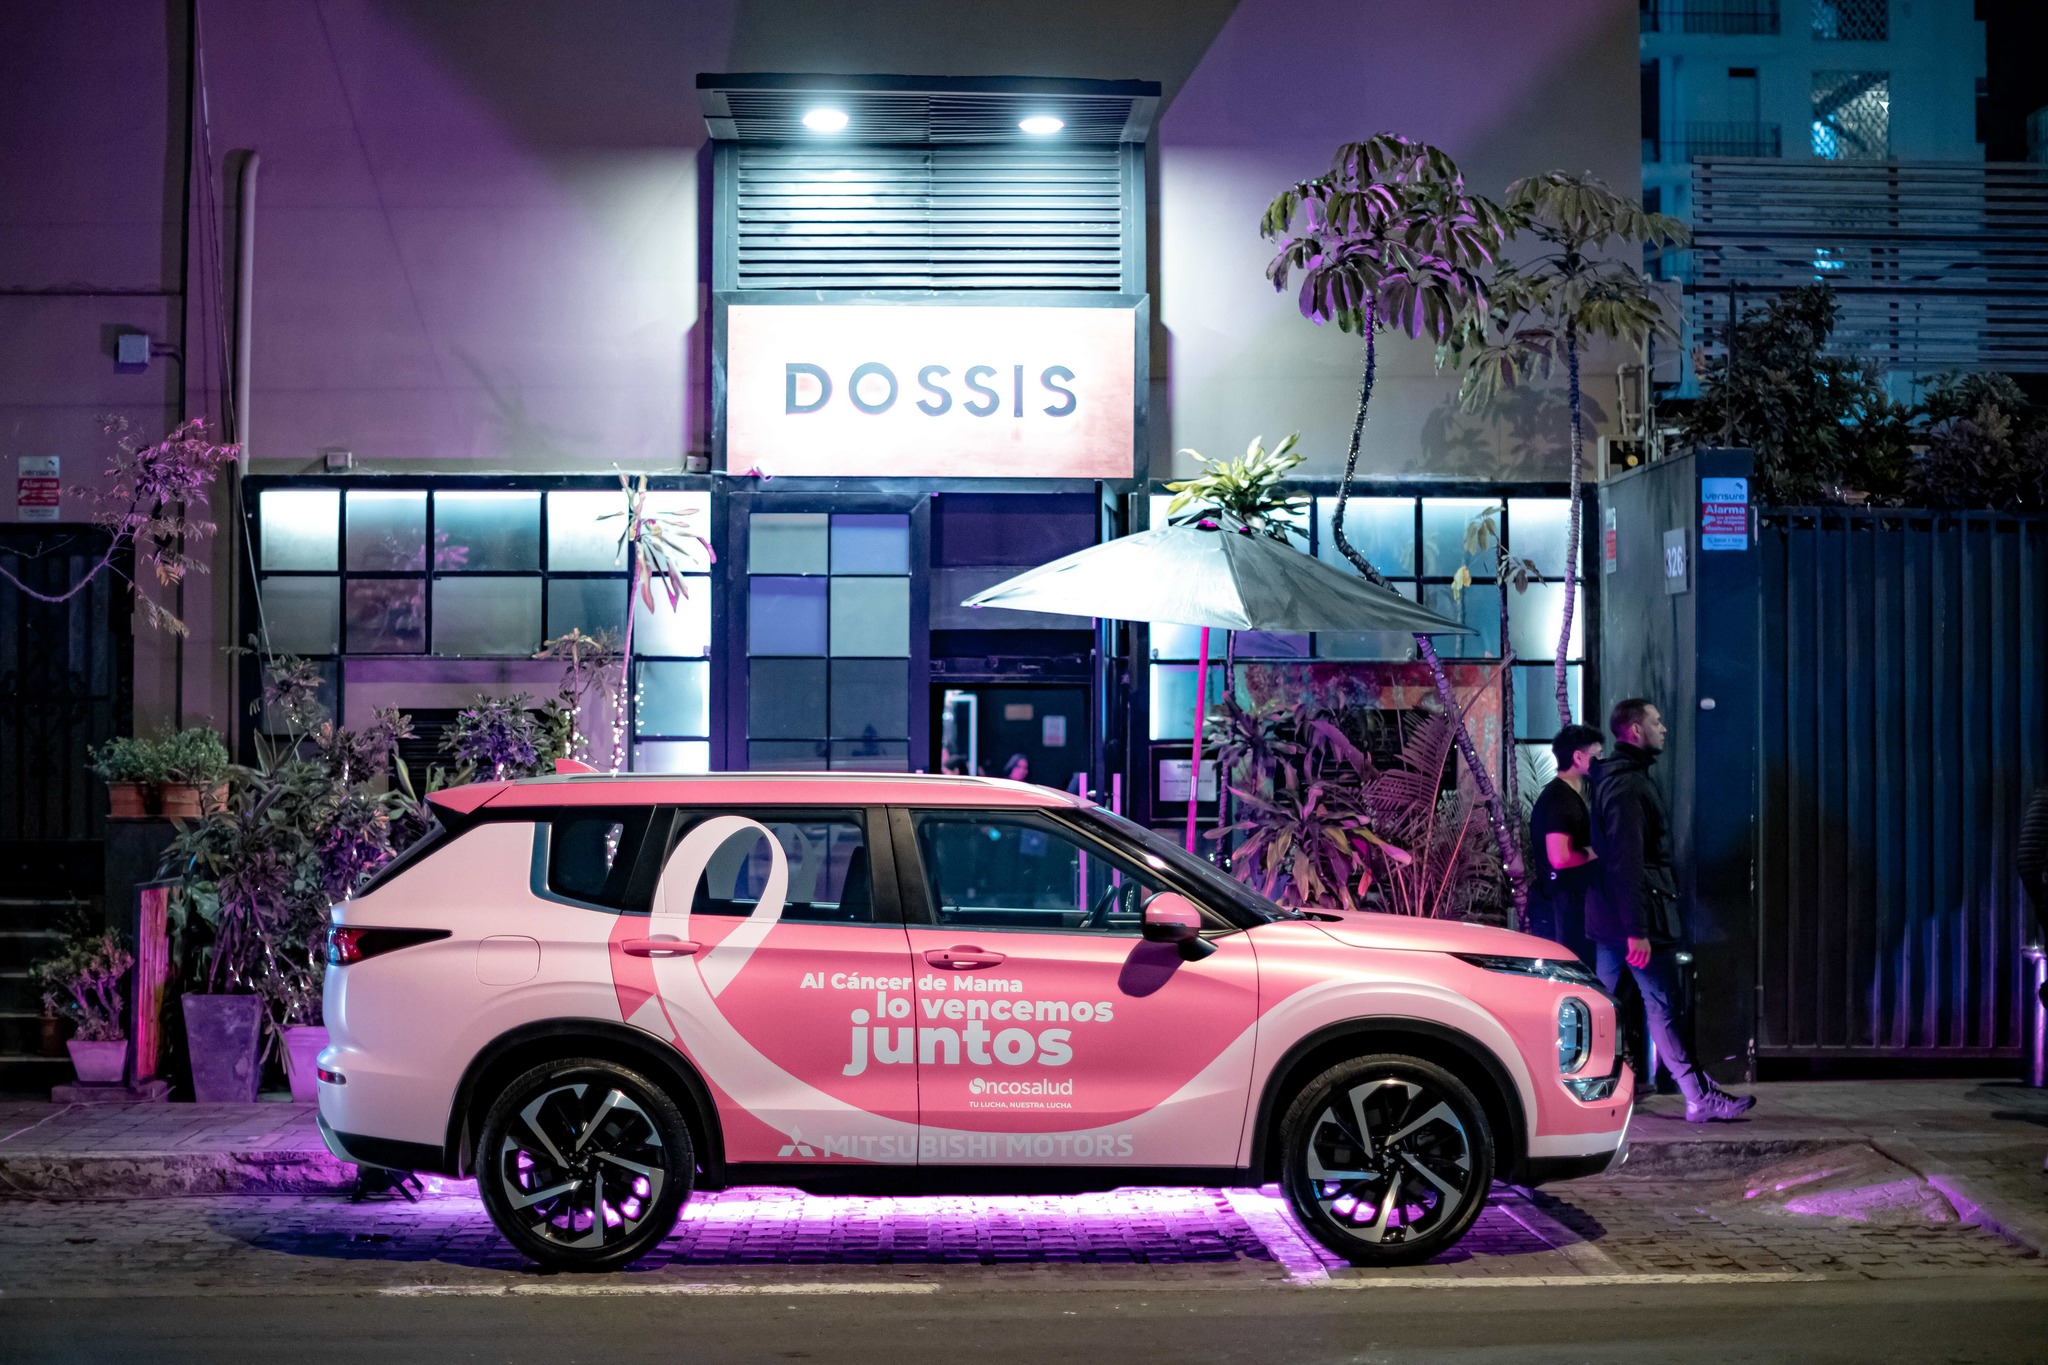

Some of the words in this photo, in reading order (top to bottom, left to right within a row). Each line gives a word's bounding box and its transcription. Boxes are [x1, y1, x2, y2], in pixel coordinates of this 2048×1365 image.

[785, 361, 1077, 418] DOSSIS
[1706, 504, 1745, 514] Alarma
[1667, 546, 1683, 578] 326
[800, 972, 825, 989] Al
[831, 972, 912, 991] Cáncer
[918, 974, 947, 991] de
[953, 975, 1023, 993] Mama
[877, 991, 911, 1019] lo
[921, 998, 1114, 1022] vencemos
[842, 1008, 1073, 1076] juntos
[968, 1077, 1073, 1096] Oncosalud
[980, 1101, 1009, 1109] LUCHA,
[1009, 1101, 1044, 1109] NUESTRA
[824, 1134, 997, 1159] MITSUBISHI
[1007, 1133, 1134, 1158] MOTORS
